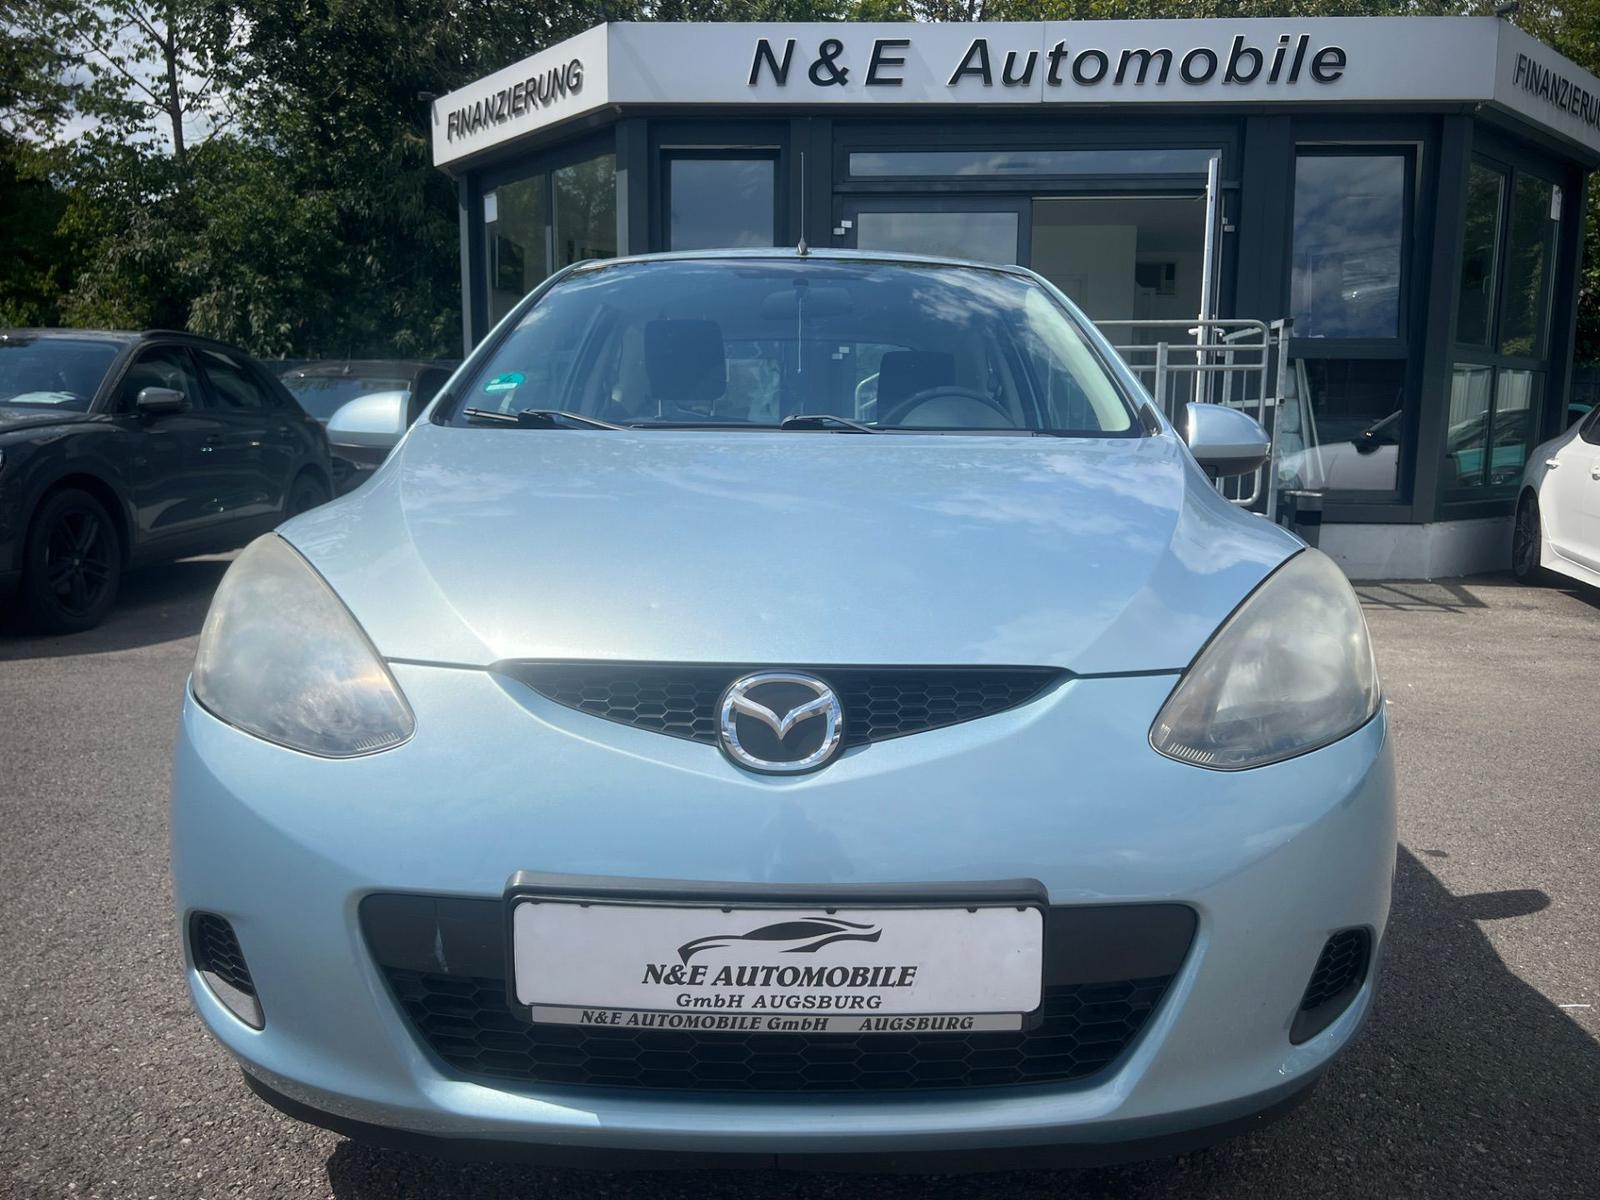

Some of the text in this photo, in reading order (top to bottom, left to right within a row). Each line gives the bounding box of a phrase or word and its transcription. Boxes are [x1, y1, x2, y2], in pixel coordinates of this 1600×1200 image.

[947, 34, 1348, 88] Automobile
[447, 58, 583, 142] FINANZIERUNG
[1514, 52, 1600, 129] FINANZIERU
[641, 963, 918, 988] N&E AUTOMOBILE
[579, 1010, 974, 1032] N&E AUTOMOBILE GmbH AUGSBURG
[676, 993, 883, 1010] GmbH AUGSBURG
